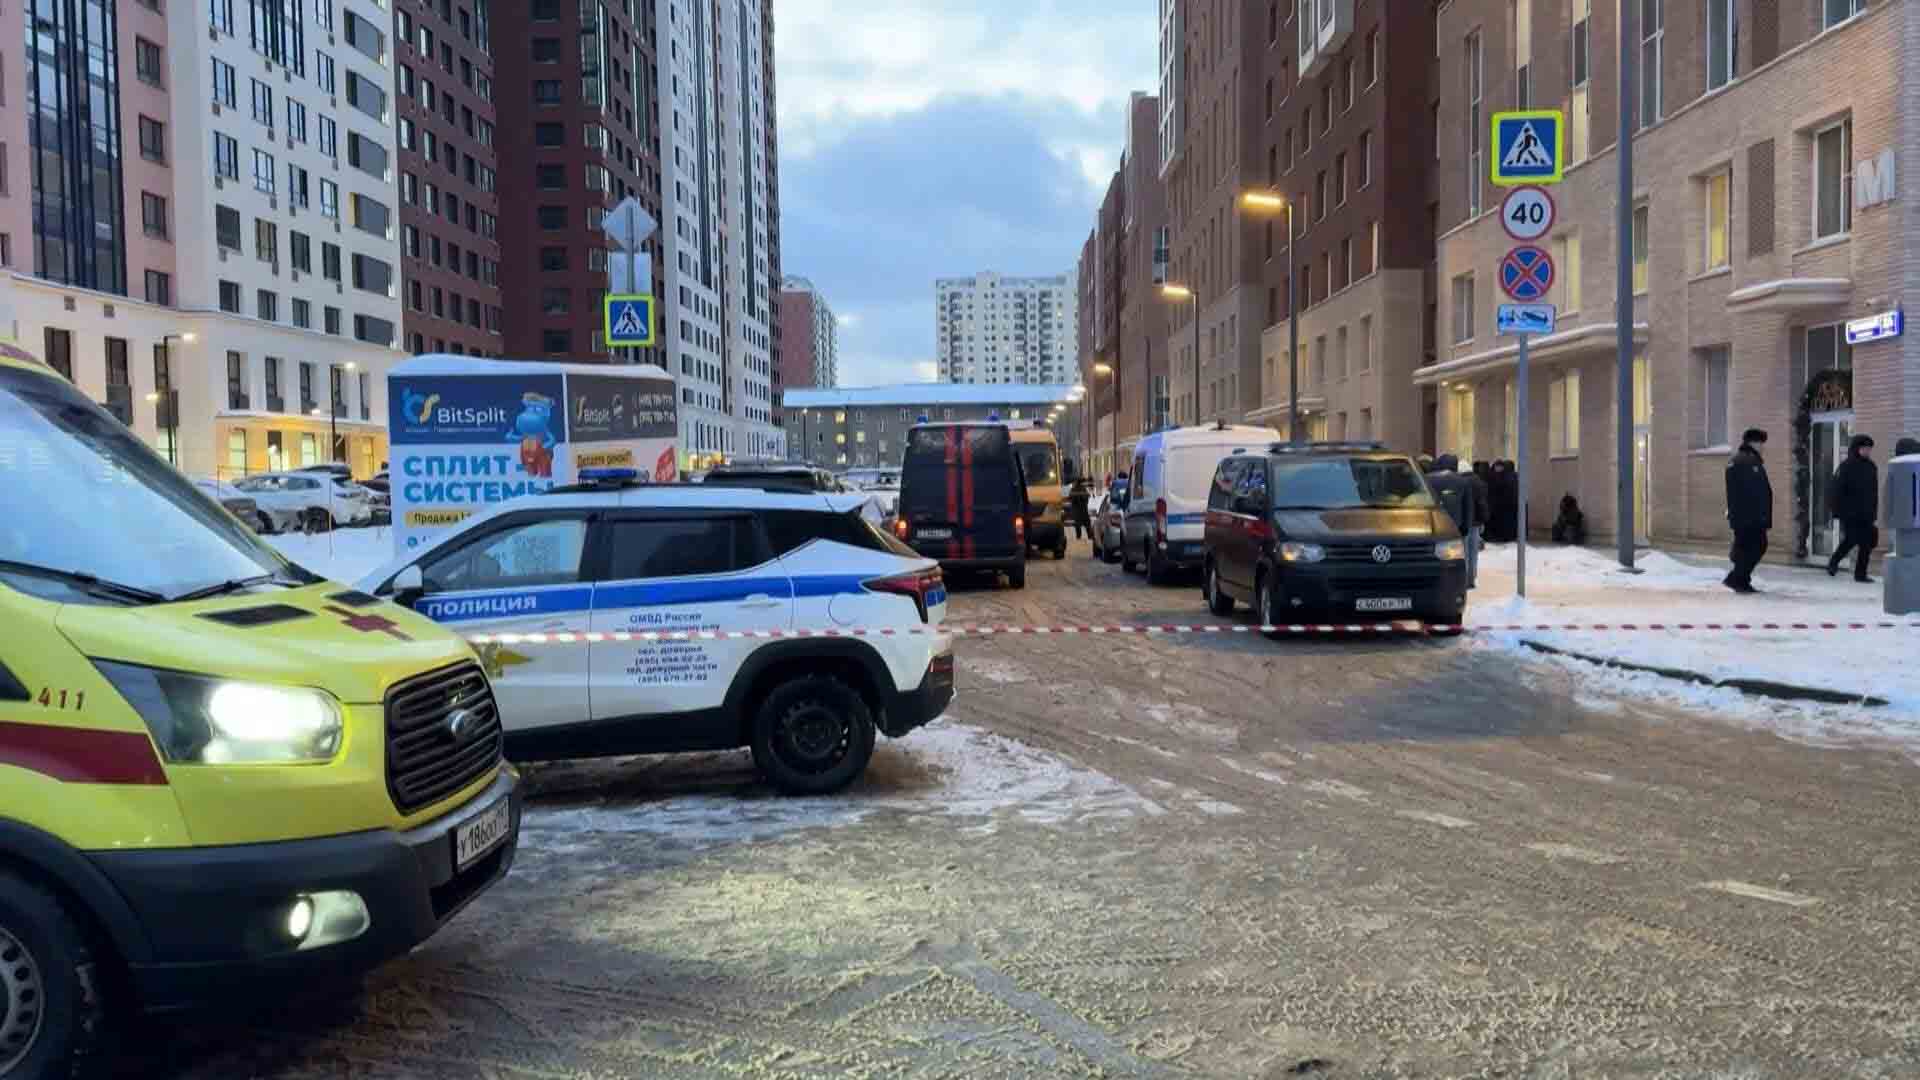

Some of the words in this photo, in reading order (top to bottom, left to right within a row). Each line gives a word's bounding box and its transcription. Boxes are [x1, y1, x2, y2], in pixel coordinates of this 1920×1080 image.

[1511, 202, 1545, 225] 40
[437, 407, 506, 427] BitSplit
[427, 596, 537, 617] ПОЛИЦИЯ
[629, 613, 662, 625] ОМВД
[38, 687, 84, 710] 411
